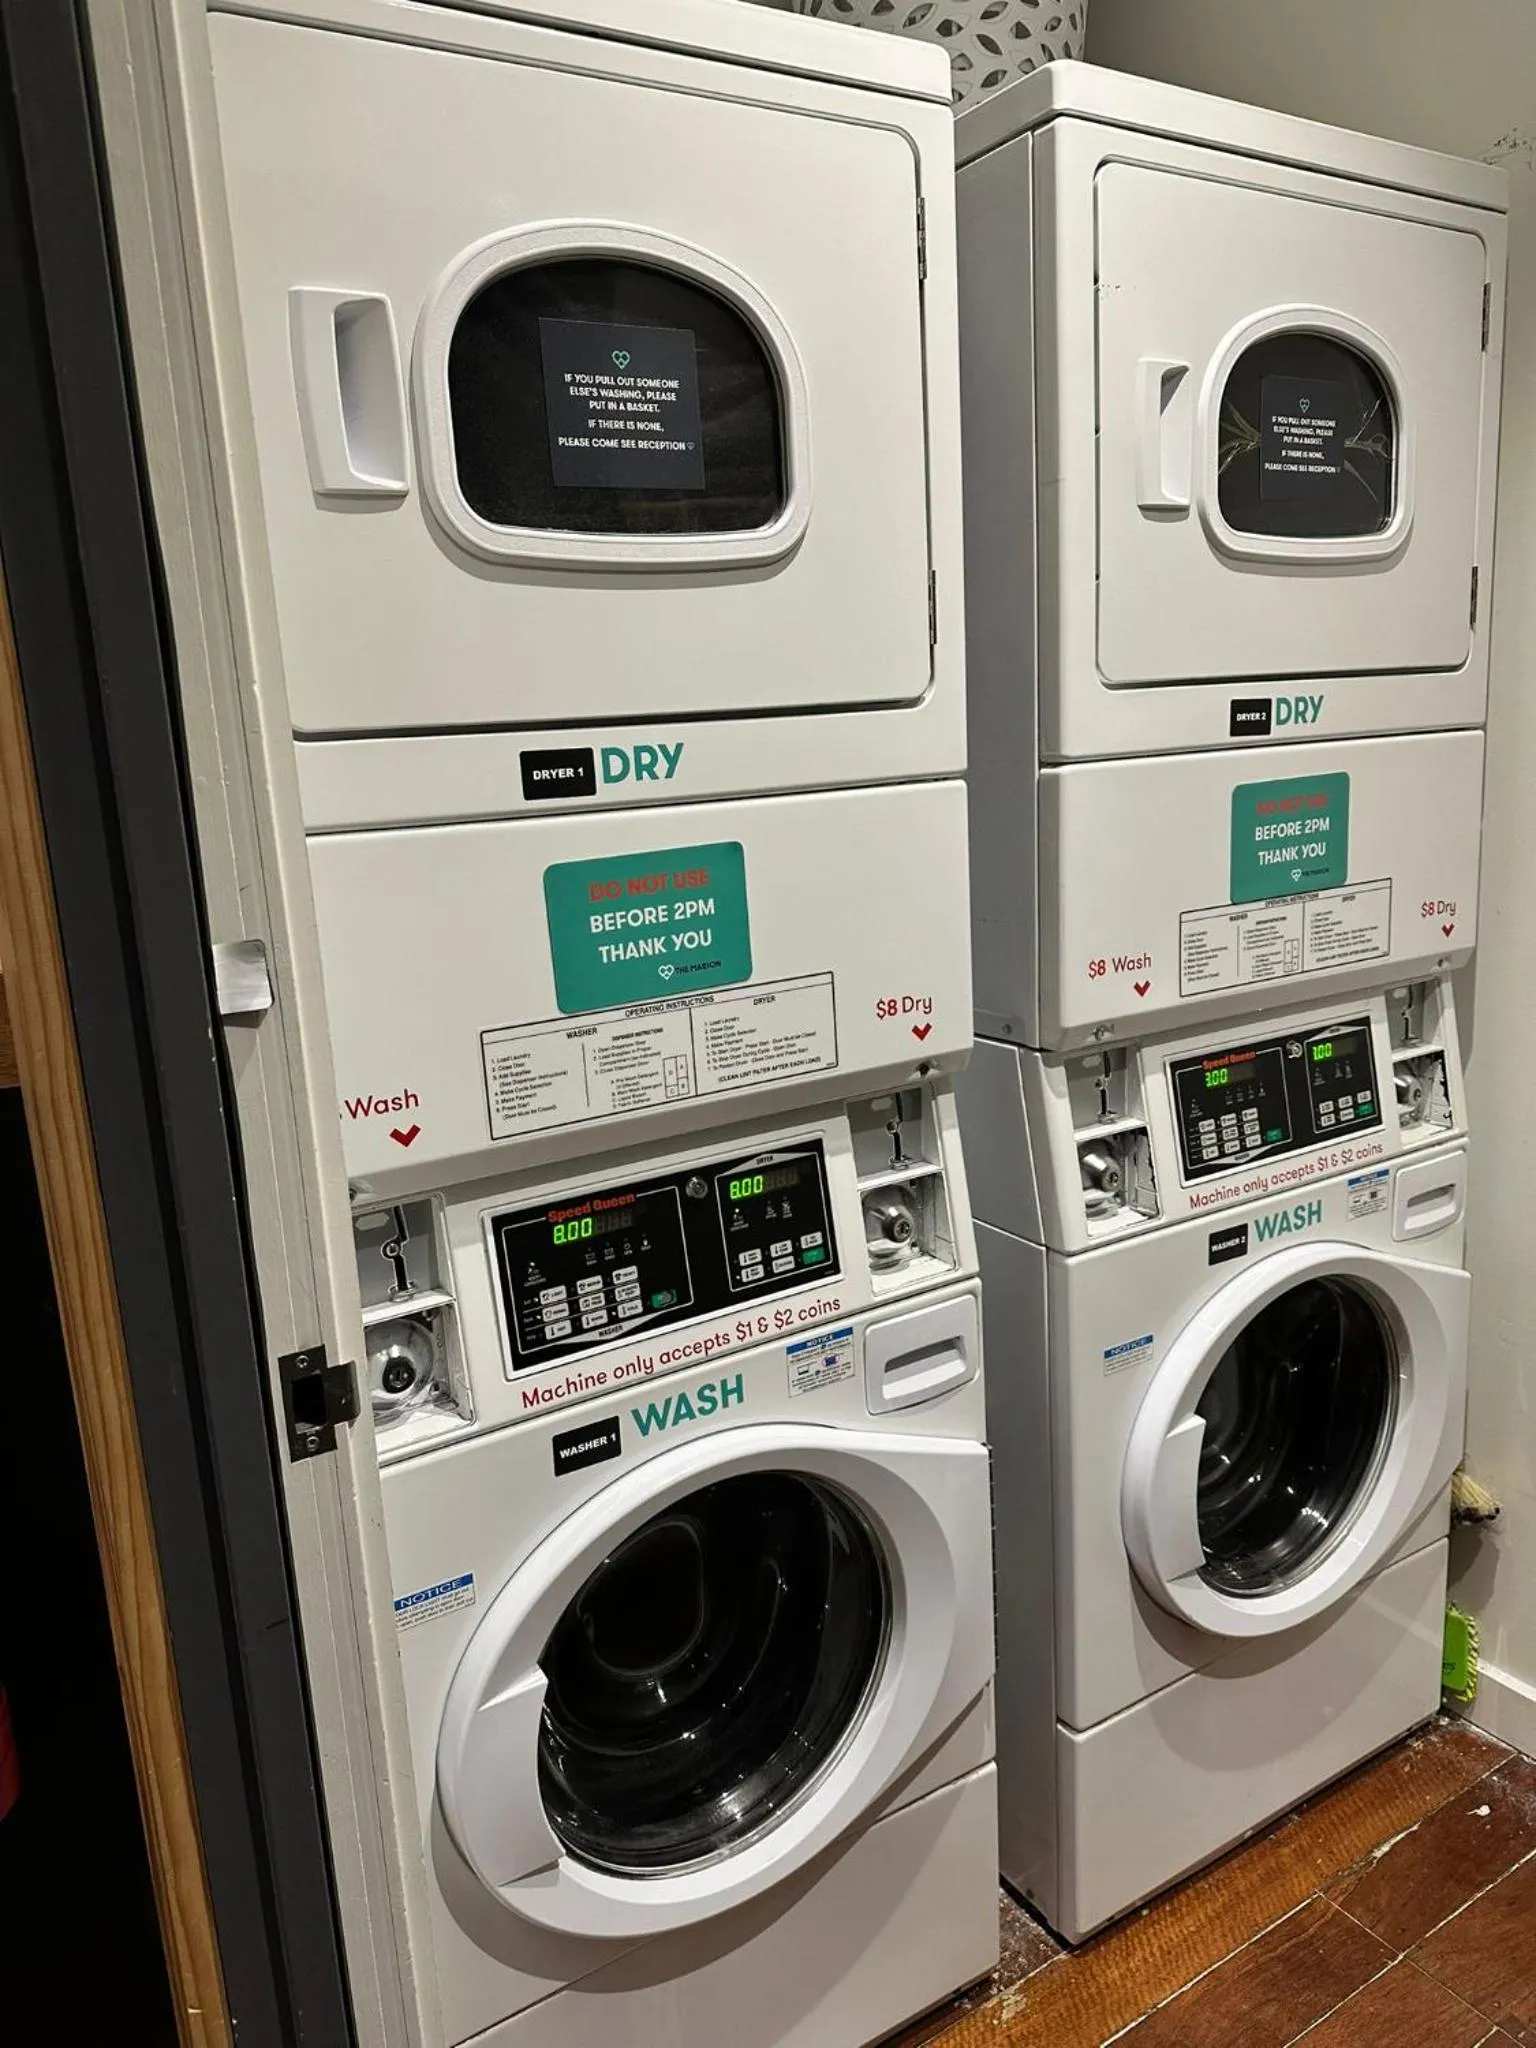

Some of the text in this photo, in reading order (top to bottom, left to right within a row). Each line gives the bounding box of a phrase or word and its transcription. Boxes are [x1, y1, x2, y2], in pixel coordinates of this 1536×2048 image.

[564, 374, 680, 388] IF YOU PULL OUT SOMEONE
[569, 386, 598, 396] ELSE'S
[646, 391, 677, 401] PLEASE
[589, 401, 606, 410] PUT
[607, 401, 617, 410] IN
[619, 402, 625, 410] A
[588, 419, 597, 428] IF
[598, 420, 625, 429] THERE
[626, 421, 636, 430] IS
[558, 437, 686, 450] PLEASE COME SEE RECEPTION
[1236, 712, 1266, 721] DRYER 2
[1276, 695, 1324, 726] DRY
[533, 767, 584, 780] DRYER 1
[600, 742, 684, 784] DRY
[1255, 817, 1330, 841] BEFORE 2PM
[1258, 842, 1327, 866] THANK YOU
[588, 869, 709, 902] DO NOT USE
[590, 898, 715, 933] BEFORE 2PM
[1421, 900, 1456, 918] $8 Dry
[598, 929, 712, 964] THANK YOU
[675, 960, 721, 974] THE MARION
[1088, 953, 1151, 980] $8 Wash
[625, 995, 714, 1017] OPERATING INSTRUCTIONS
[753, 995, 776, 1005] DRYER
[876, 996, 932, 1020] $8 Dry
[566, 1027, 598, 1039] WASHER
[344, 1088, 419, 1119] Wash
[730, 1175, 763, 1200] 8.00
[1190, 1143, 1383, 1209] Machine only accepts $1 & $2 coins
[548, 1194, 636, 1222] Speed Queen
[554, 1217, 592, 1244] 8.00
[1254, 1200, 1322, 1242] WASH
[1212, 1236, 1246, 1253] WASHER 2
[521, 1297, 840, 1409] Machine only accepts $1 & $2 coins
[630, 1374, 744, 1437] WASH
[560, 1436, 608, 1459] WASHER
[400, 1580, 461, 1608] NOTICE
